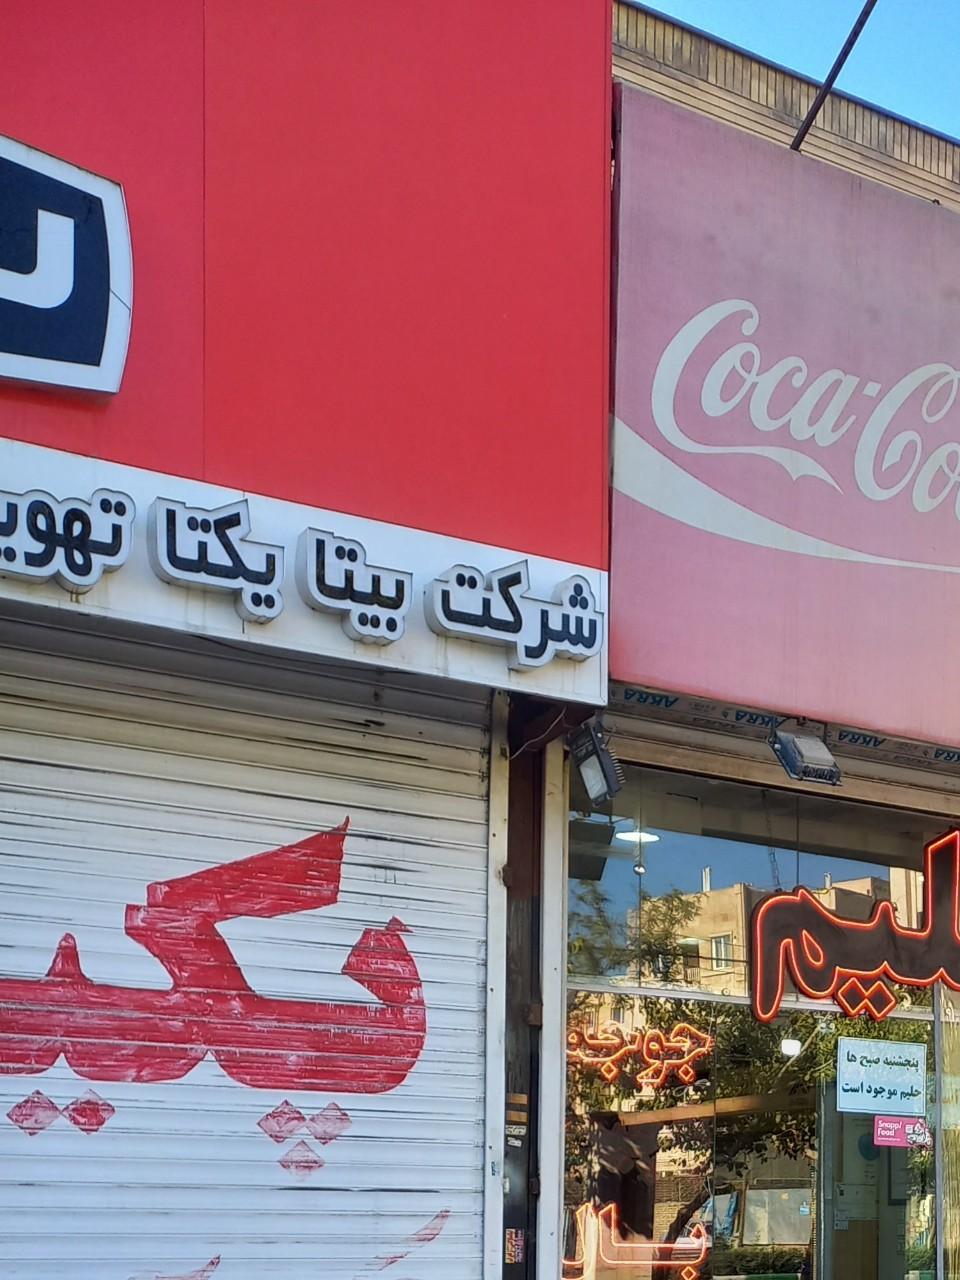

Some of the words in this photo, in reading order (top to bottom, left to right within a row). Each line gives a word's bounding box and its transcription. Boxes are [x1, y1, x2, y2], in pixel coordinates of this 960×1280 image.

[0, 498, 127, 577] تهوی
[165, 508, 277, 609] یکتا
[315, 536, 406, 633] بیتا
[440, 570, 597, 660] شرکت
[0, 816, 426, 1178] پکی
[846, 1051, 858, 1063] ها
[859, 1054, 881, 1069] صبح
[883, 1055, 919, 1073] پنجشنبه
[841, 1082, 864, 1094] است
[866, 1086, 898, 1100] موجود
[900, 1085, 922, 1101] حلیم
